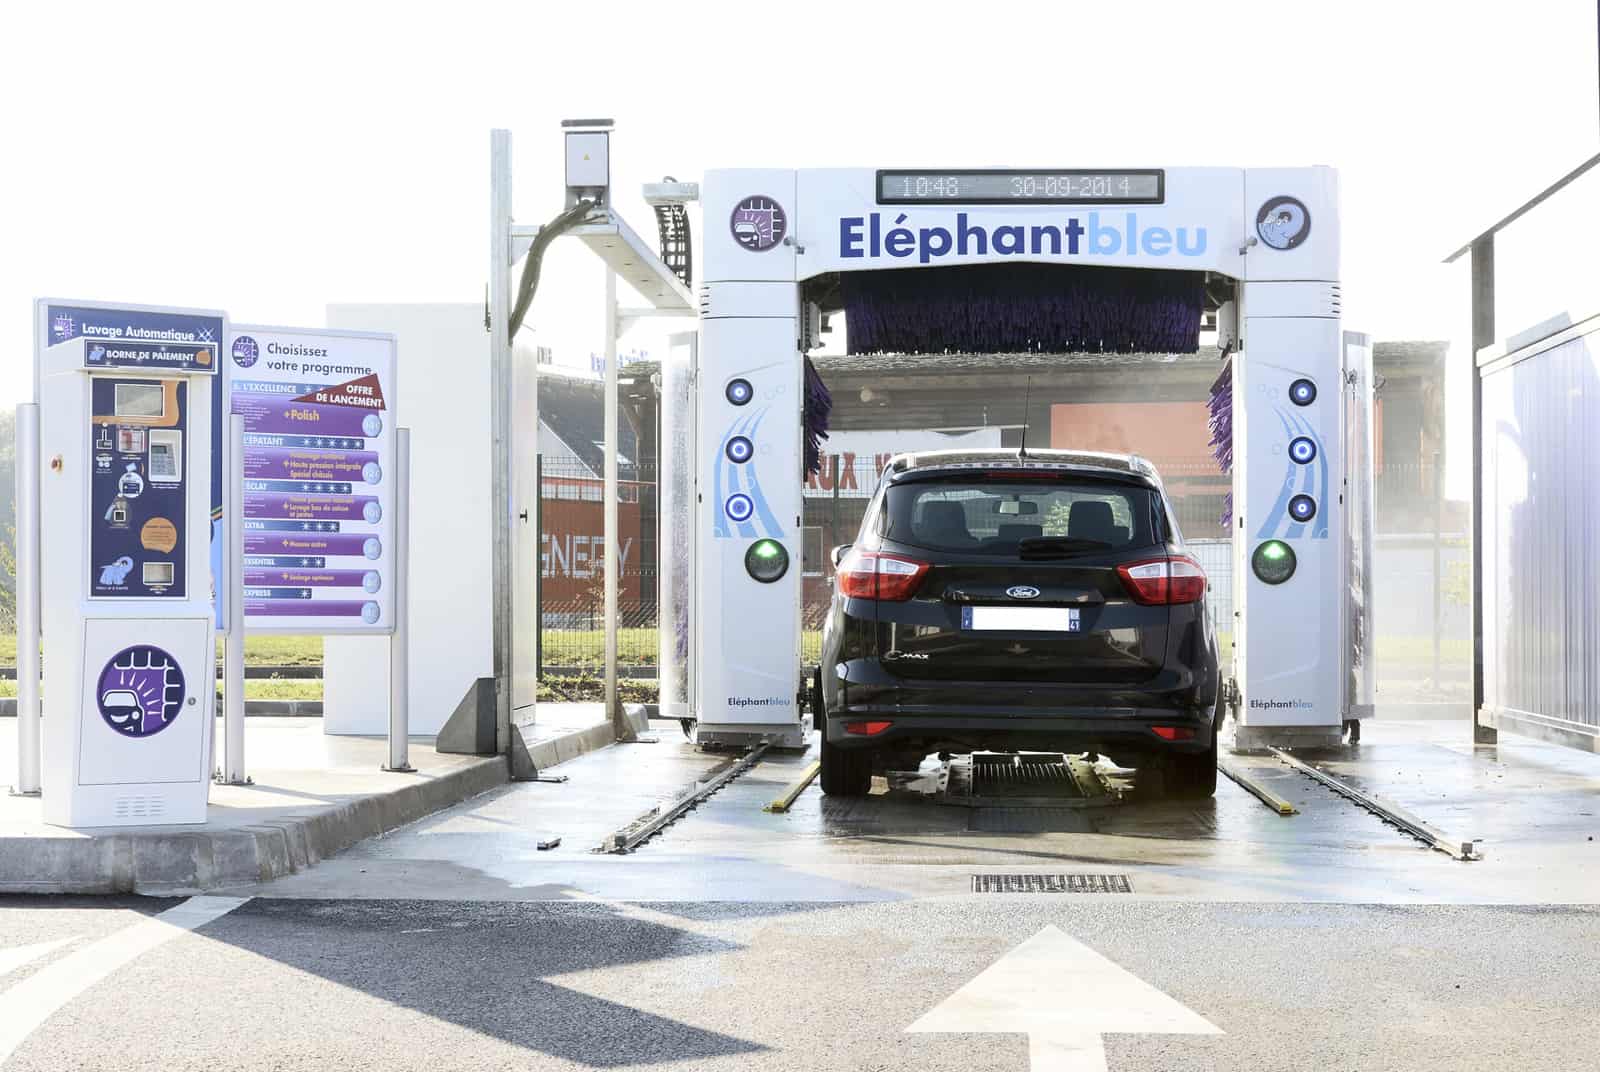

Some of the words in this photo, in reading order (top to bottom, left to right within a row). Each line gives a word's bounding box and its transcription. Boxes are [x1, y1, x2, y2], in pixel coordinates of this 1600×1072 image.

[901, 176, 960, 197] 10:48
[1009, 175, 1131, 197] 30-09-2014
[82, 323, 122, 338] Lavage
[125, 325, 195, 341] Automatique
[106, 350, 137, 360] BORNE
[138, 350, 150, 360] DE
[152, 350, 194, 361] PAIEMENT
[267, 343, 328, 357] Choisissez
[267, 361, 298, 371] votre
[302, 363, 372, 376] programme
[346, 384, 373, 395] OFFRE
[316, 393, 328, 402] DE
[330, 394, 382, 407] LANCEMENT
